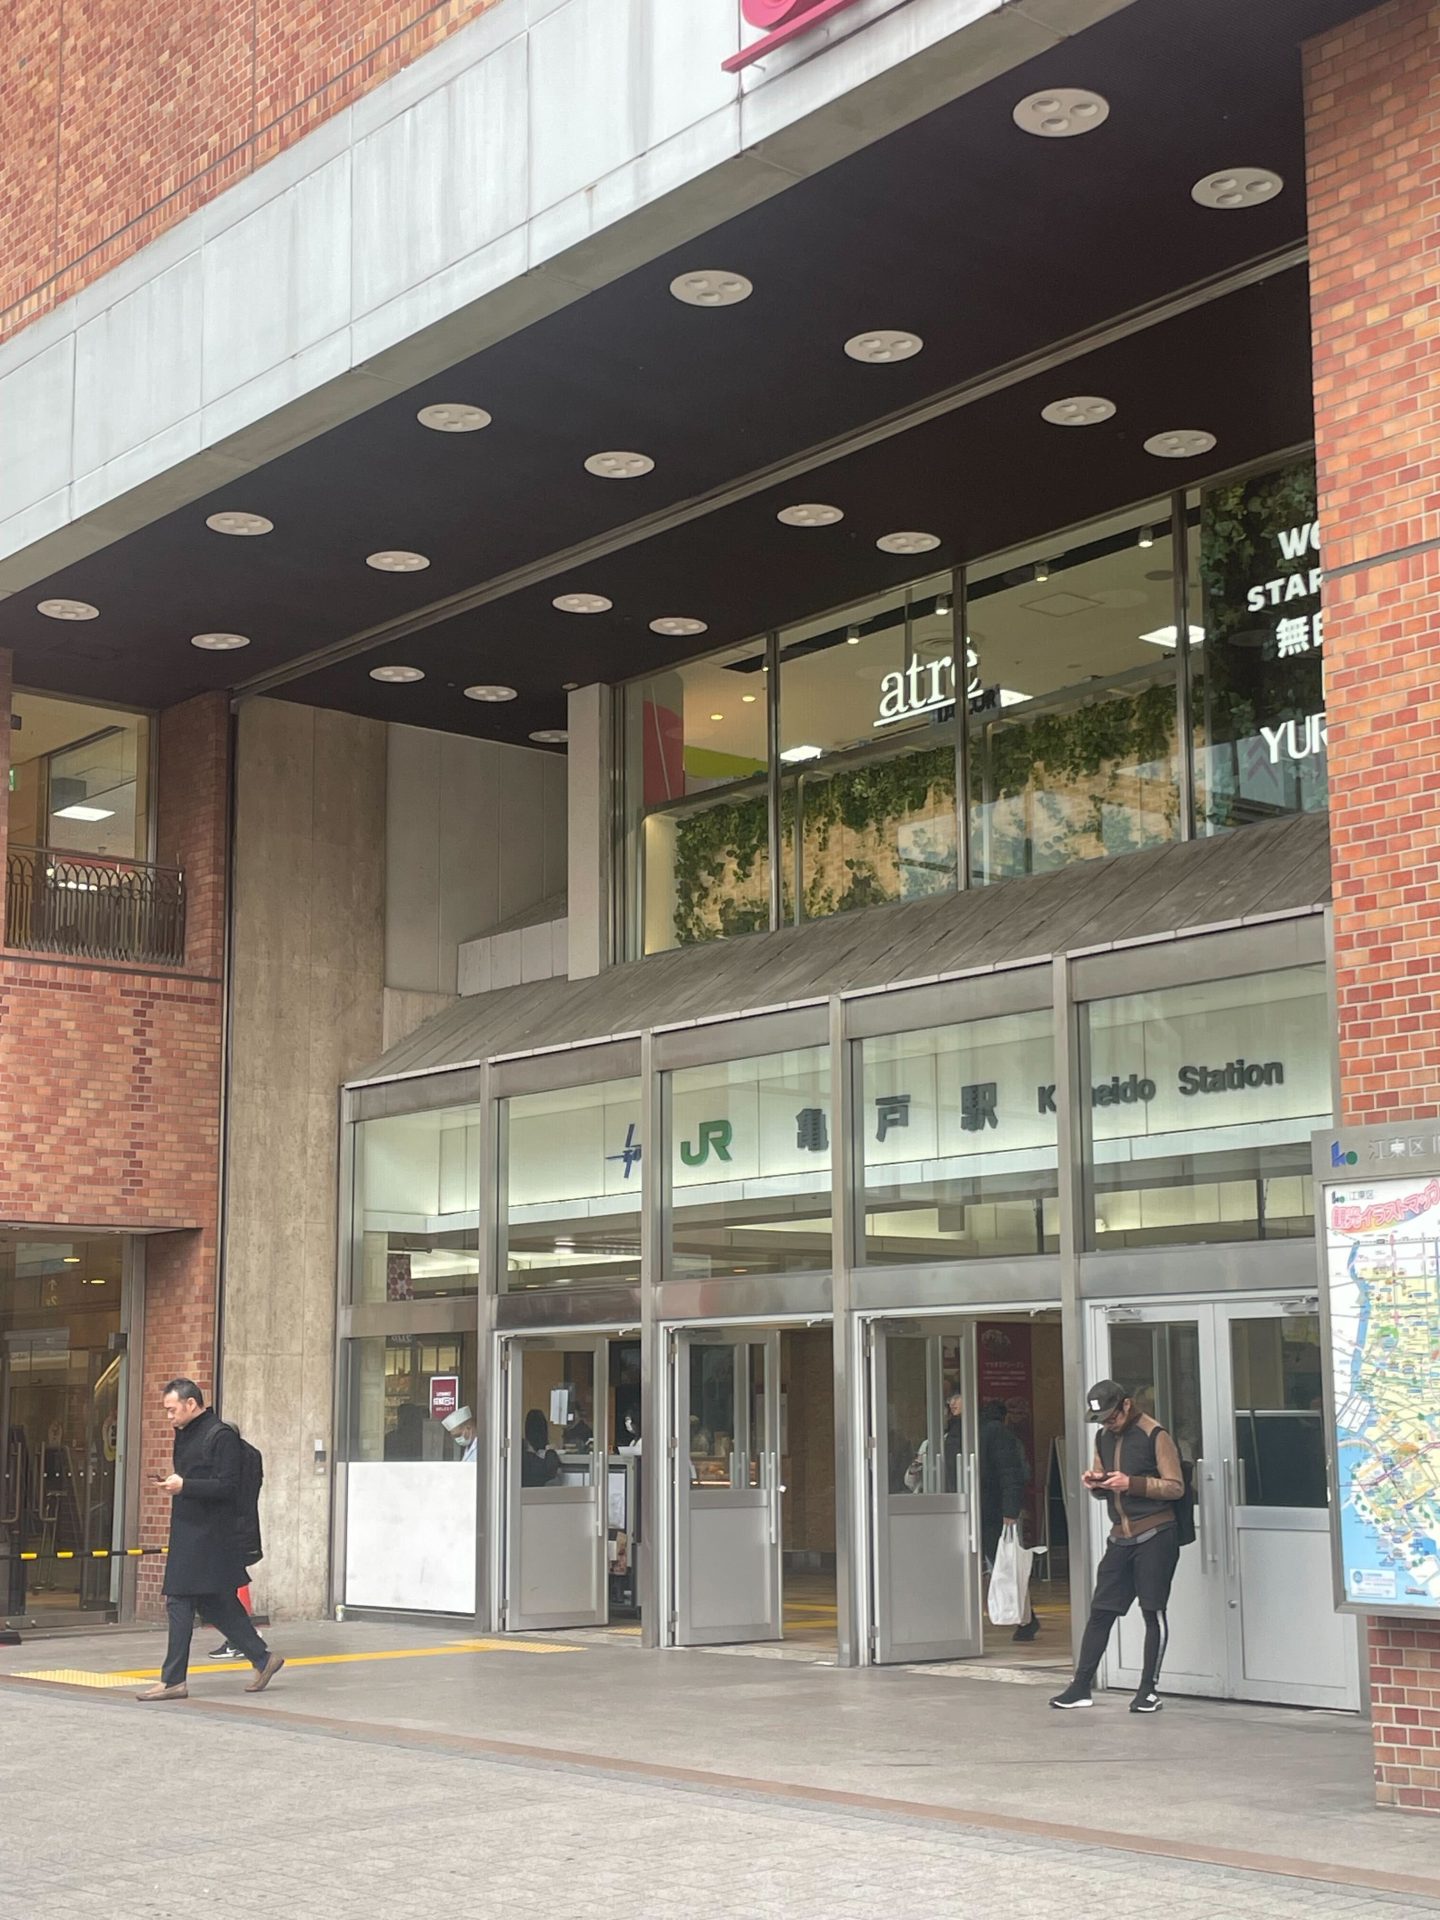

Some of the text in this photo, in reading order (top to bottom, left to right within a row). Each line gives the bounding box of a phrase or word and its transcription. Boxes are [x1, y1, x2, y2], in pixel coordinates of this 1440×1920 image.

[680, 1059, 1284, 1166] JR 亀戸駅 Keido Station
